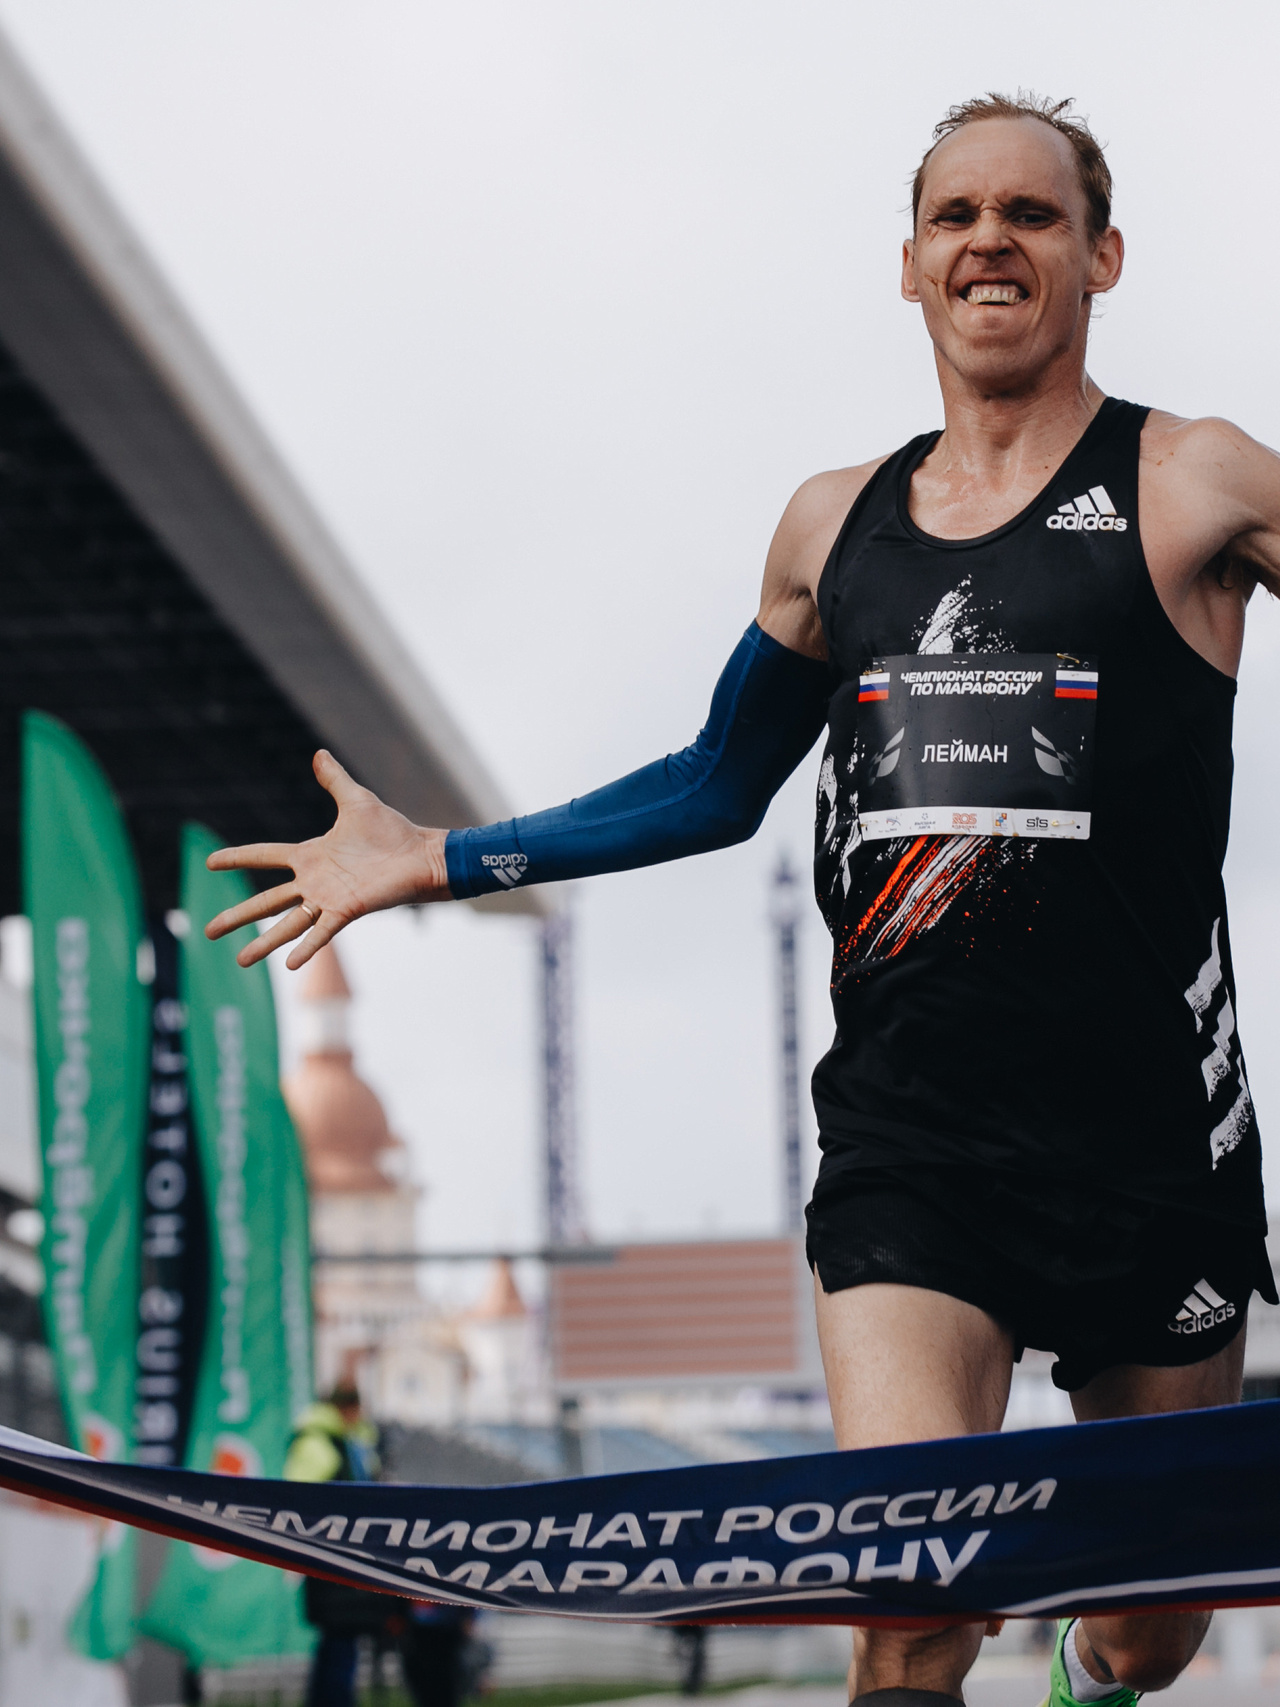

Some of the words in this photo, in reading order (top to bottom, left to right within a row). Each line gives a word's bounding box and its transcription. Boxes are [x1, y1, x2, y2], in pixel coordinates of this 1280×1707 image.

[1046, 512, 1127, 531] adidas
[901, 671, 986, 683] ЧЕМПИОНАТ
[985, 671, 1043, 682] РОССИИ
[911, 683, 933, 696] ПО
[935, 683, 1033, 696] МАРАФОНУ
[921, 739, 1008, 763] ЛЕЙМАН
[952, 813, 978, 825] ROS
[481, 853, 528, 868] adidas
[1168, 1303, 1236, 1334] adidas
[715, 1478, 1057, 1544] РОССИИ
[404, 1530, 990, 1595] МАРАФОНУ
